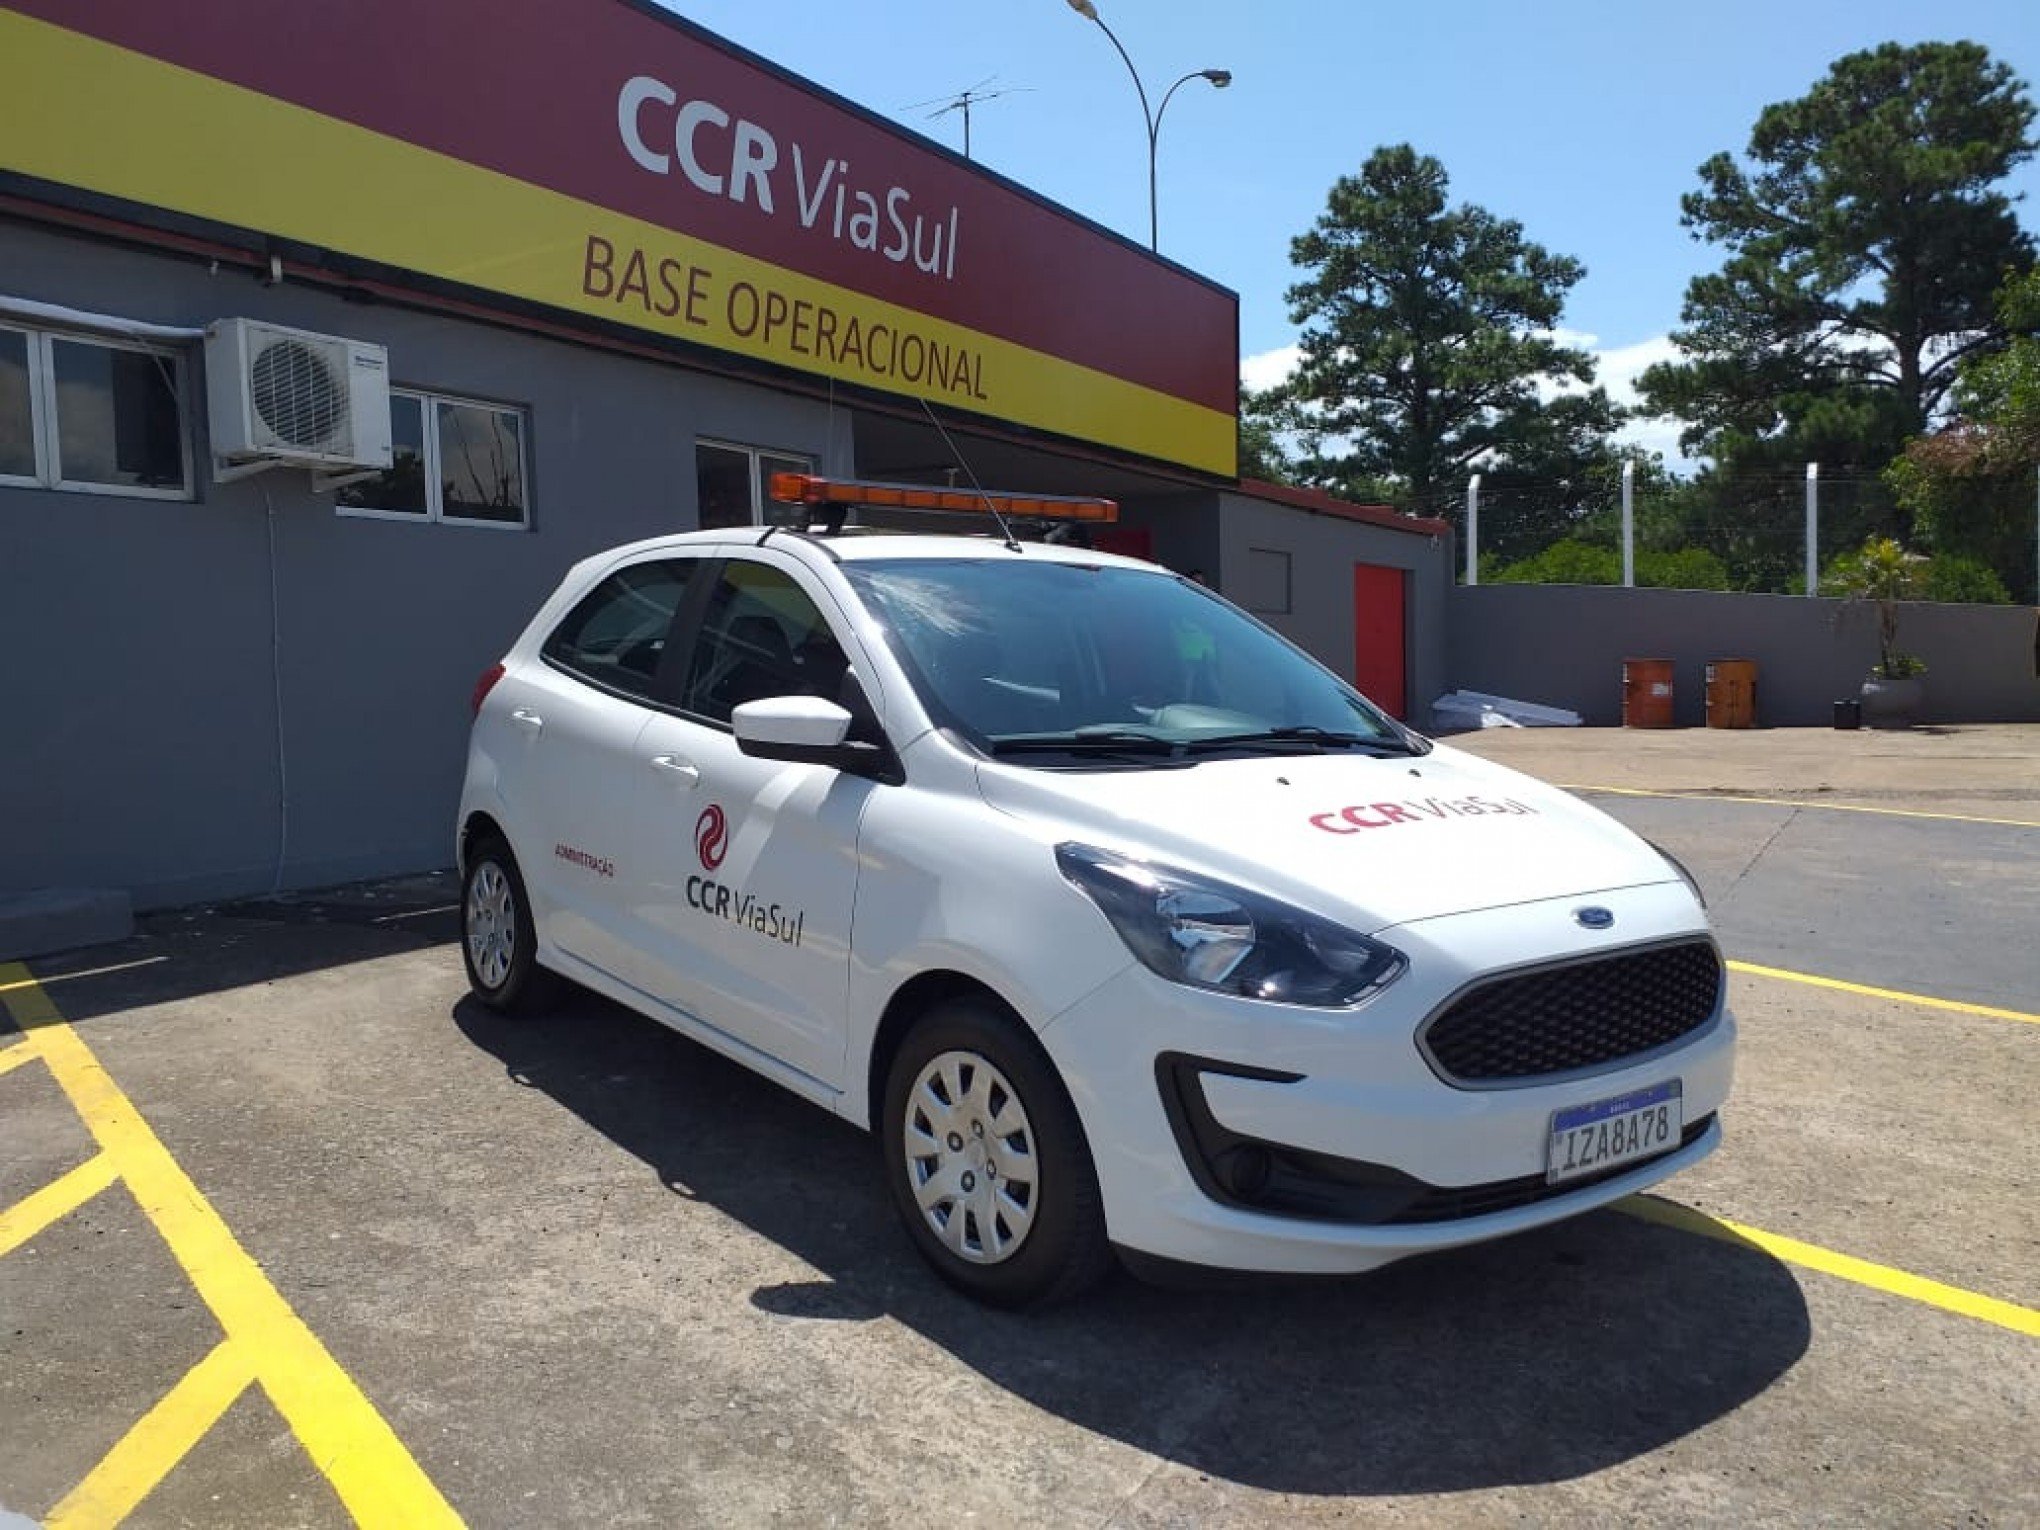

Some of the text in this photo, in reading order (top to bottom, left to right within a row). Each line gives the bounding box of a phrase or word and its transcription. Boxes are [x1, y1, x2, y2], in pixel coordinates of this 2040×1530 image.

[617, 75, 959, 280] CCR ViaSul
[582, 234, 989, 402] BASE OPERACIONAL
[1308, 802, 1424, 835] CCR
[686, 875, 804, 947] CCR ViaSul
[1563, 1106, 1669, 1171] IZA8A78
